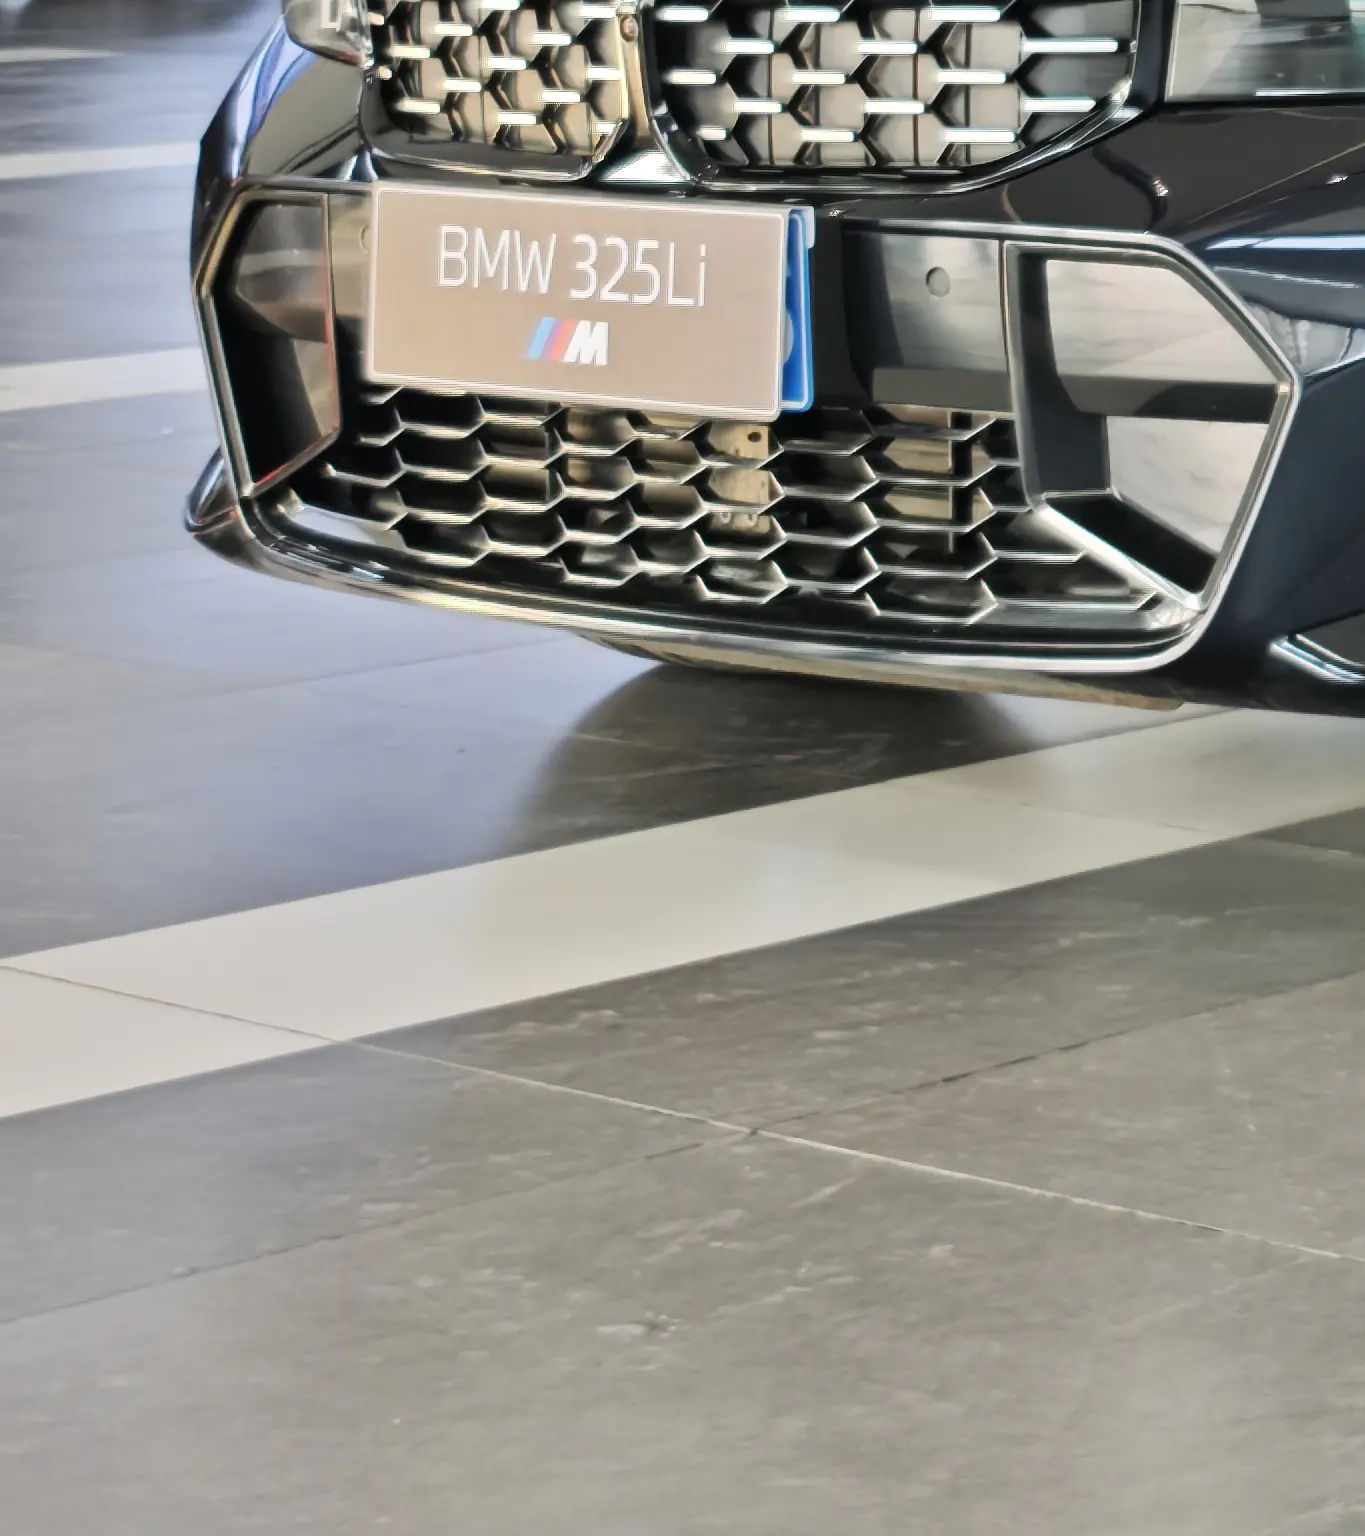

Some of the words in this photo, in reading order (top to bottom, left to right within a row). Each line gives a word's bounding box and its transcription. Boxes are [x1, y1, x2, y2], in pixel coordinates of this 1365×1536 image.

[437, 224, 557, 295] BMW
[568, 234, 707, 307] 325Li
[563, 319, 609, 366] M
